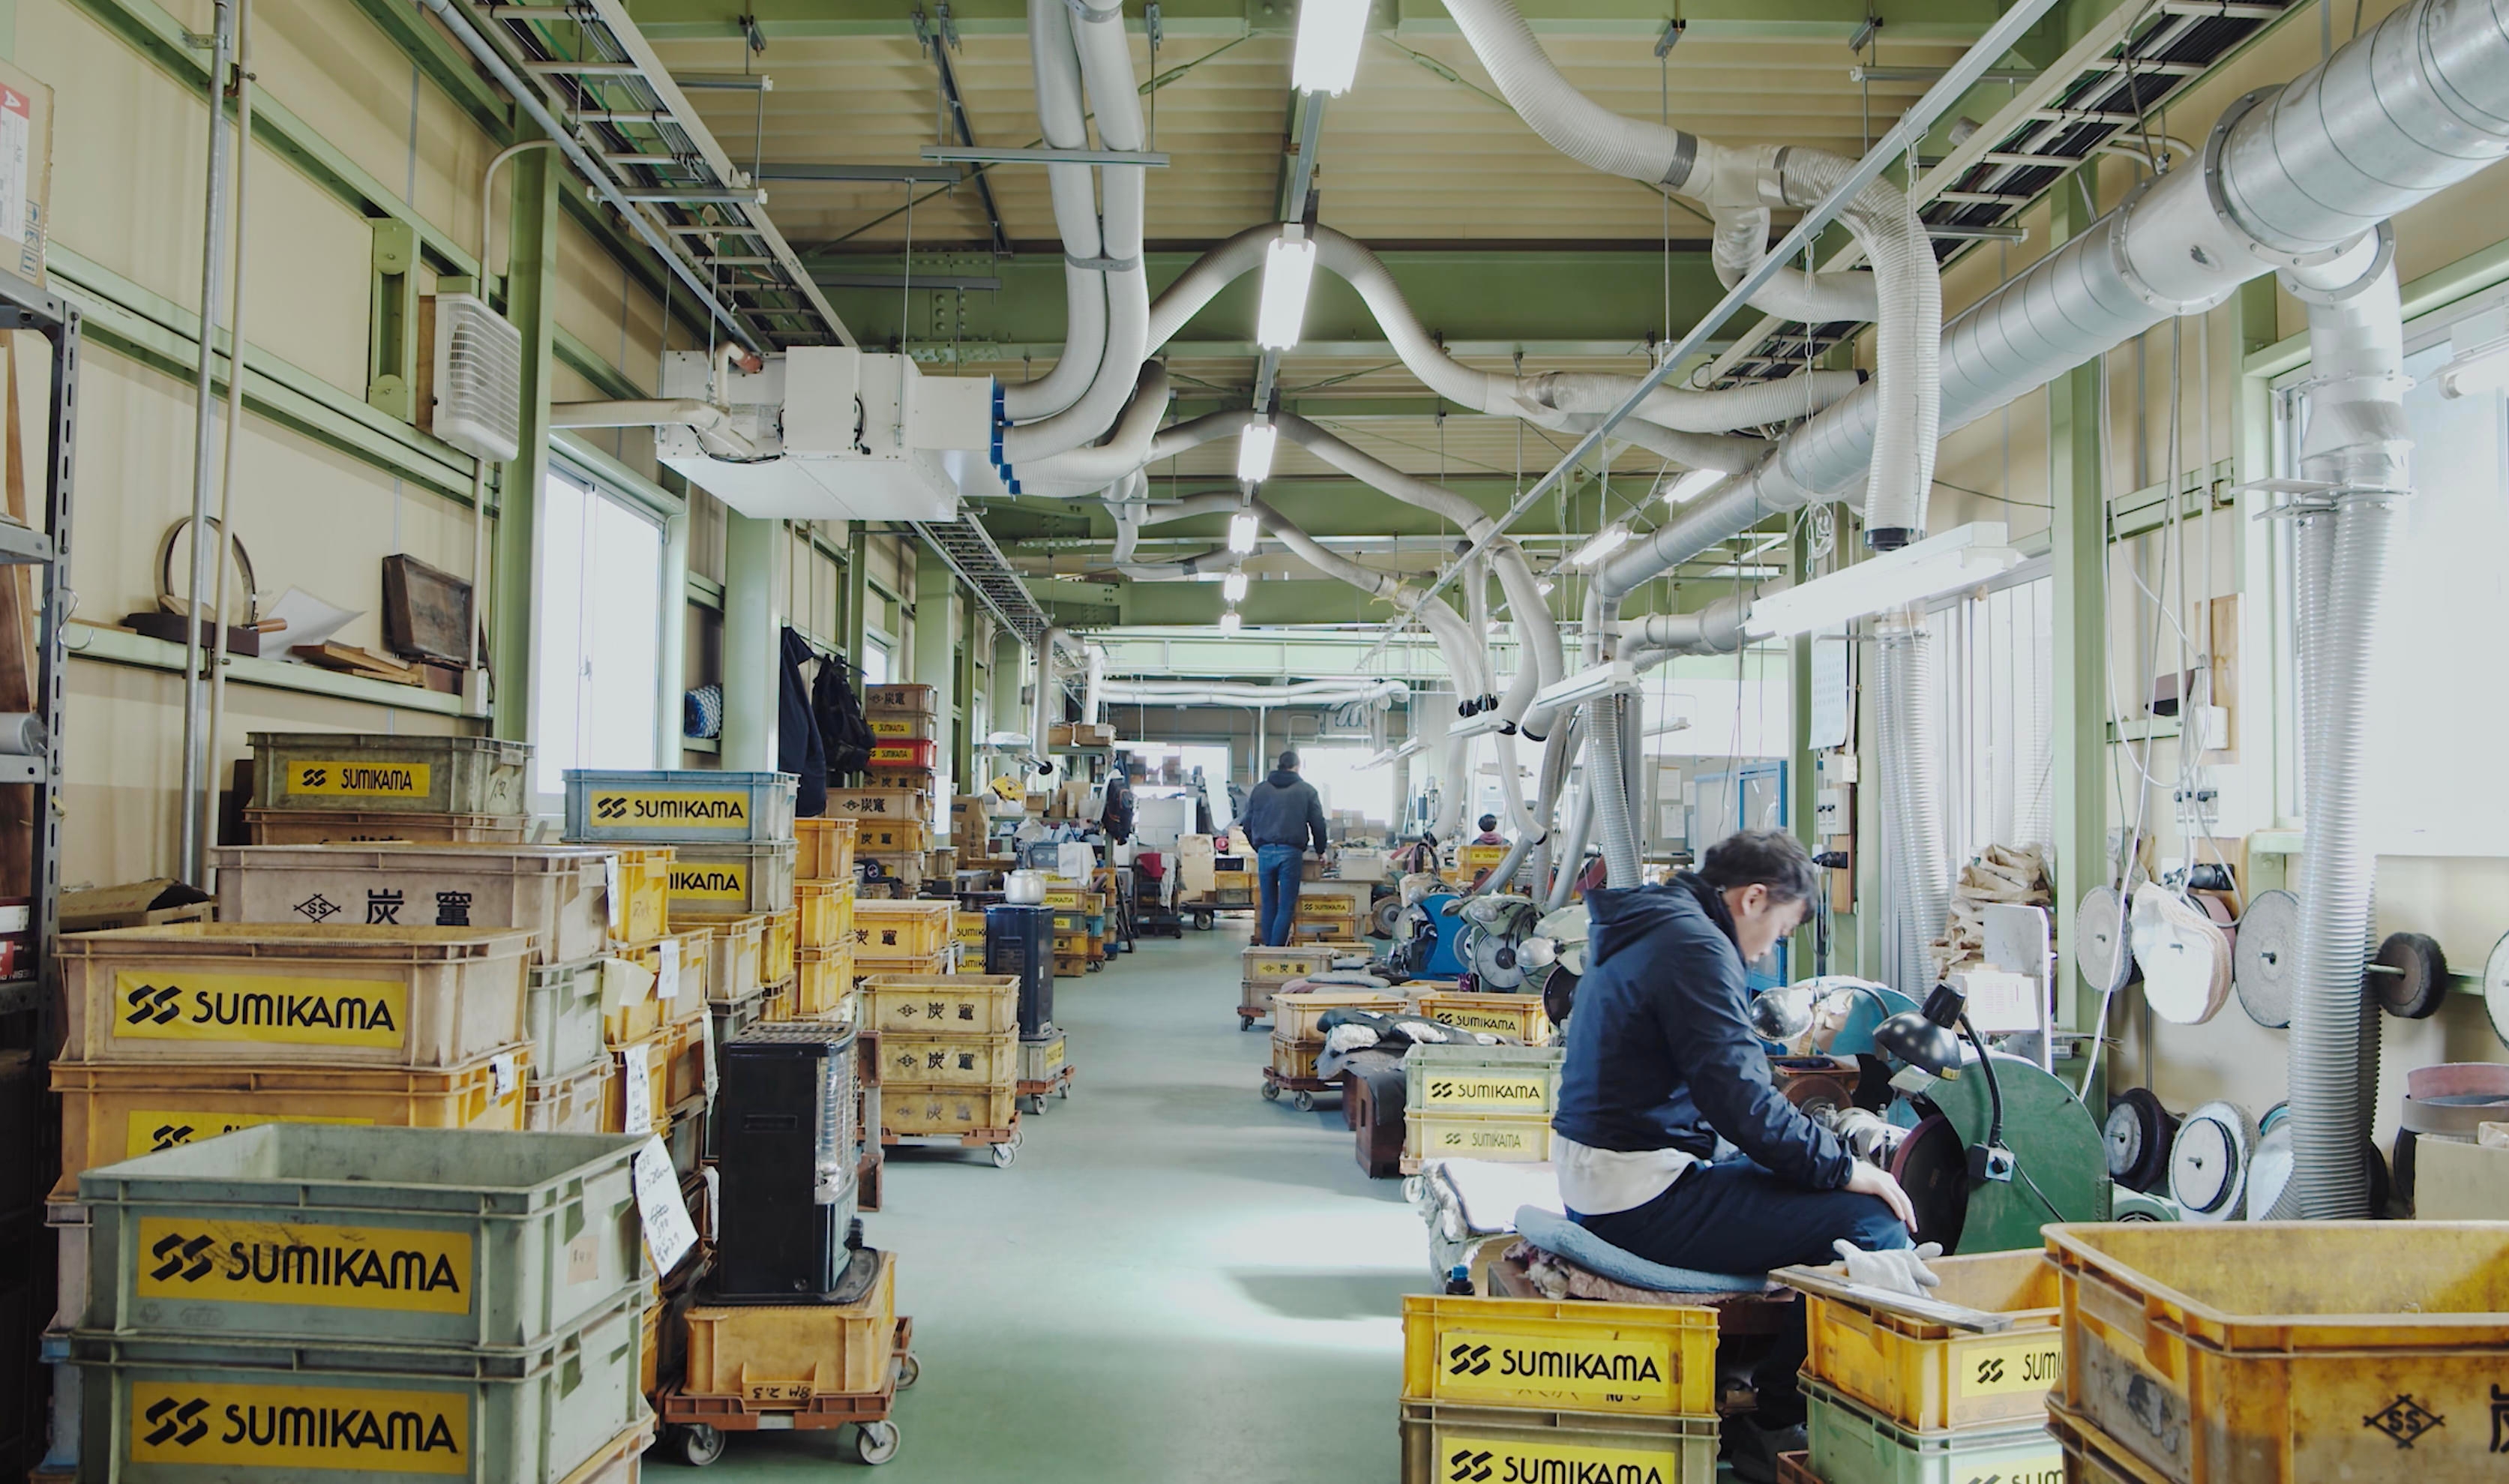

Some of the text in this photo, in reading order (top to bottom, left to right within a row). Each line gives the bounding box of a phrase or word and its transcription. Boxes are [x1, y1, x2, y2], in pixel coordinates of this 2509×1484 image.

[341, 768, 412, 790] SUMIKAMA
[634, 800, 744, 818] SUMIKAMA
[670, 873, 740, 891] IKAMA
[193, 991, 395, 1032] SUMIKAMA
[1456, 1015, 1515, 1031] SUMIKAMA
[1458, 1084, 1539, 1099] SUMIKAMA
[1472, 1132, 1521, 1147] SUMIKAMA
[226, 1242, 460, 1293] SUMIKAMA
[1500, 1349, 1661, 1382] SUMIKAMA
[2023, 1351, 2062, 1381] SUMI
[222, 1404, 458, 1453] SUMIKAMA
[1503, 1456, 1662, 1484] SUMIKAMA
